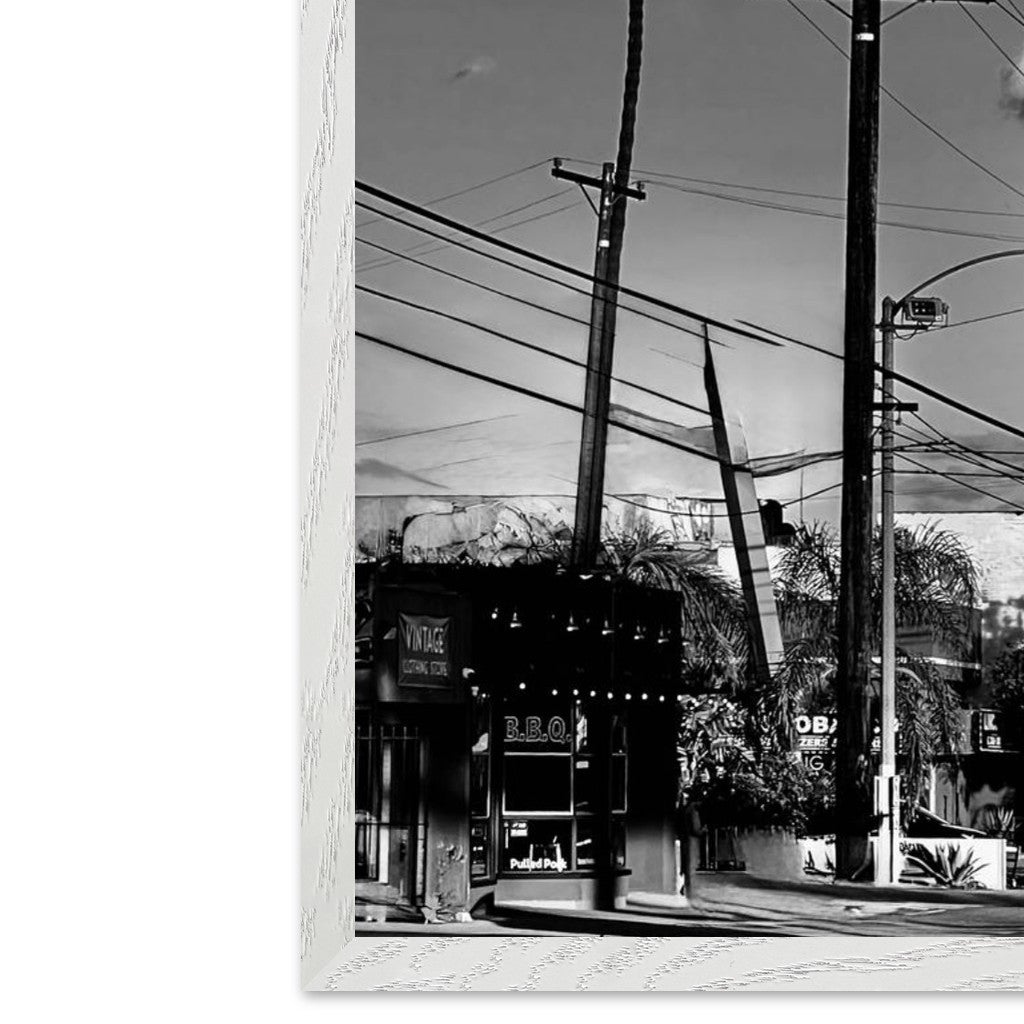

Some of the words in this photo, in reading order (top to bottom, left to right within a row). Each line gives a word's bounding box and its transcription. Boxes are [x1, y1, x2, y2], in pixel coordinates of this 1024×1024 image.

[405, 624, 444, 654] VINTAGE
[503, 715, 573, 744] B.B.Q.
[543, 858, 568, 872] Pok
